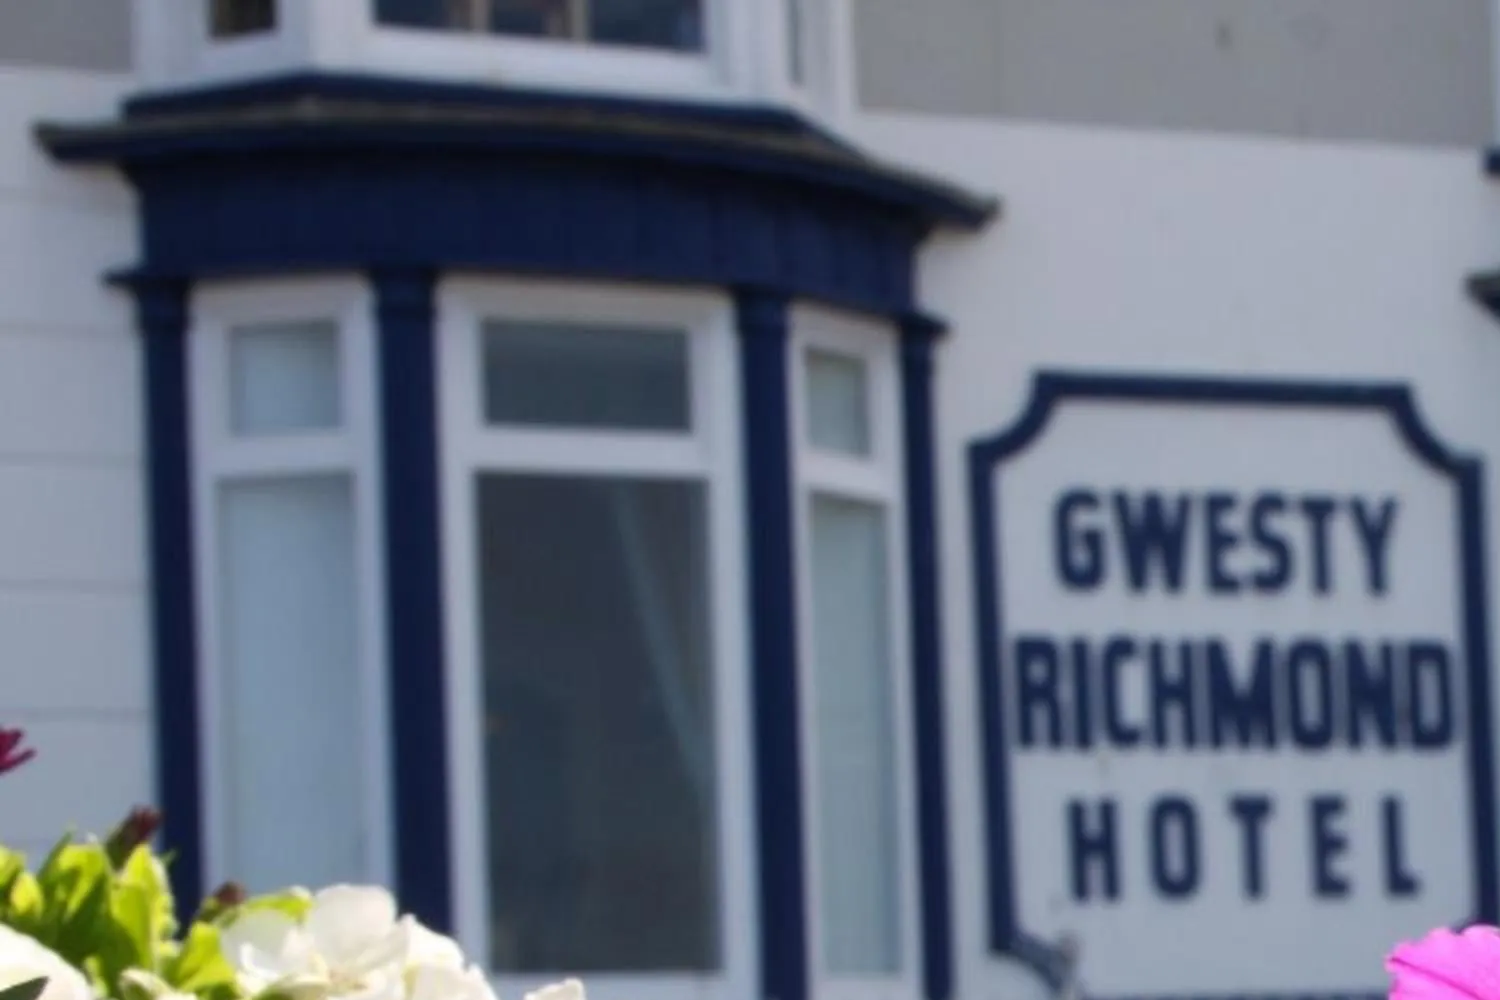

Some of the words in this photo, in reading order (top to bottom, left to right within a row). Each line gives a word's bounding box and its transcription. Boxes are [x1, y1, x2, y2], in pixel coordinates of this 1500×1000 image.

[1054, 488, 1397, 596] GWESTY
[1013, 635, 1455, 753] RICHMOND
[1067, 796, 1421, 903] HOTEL
